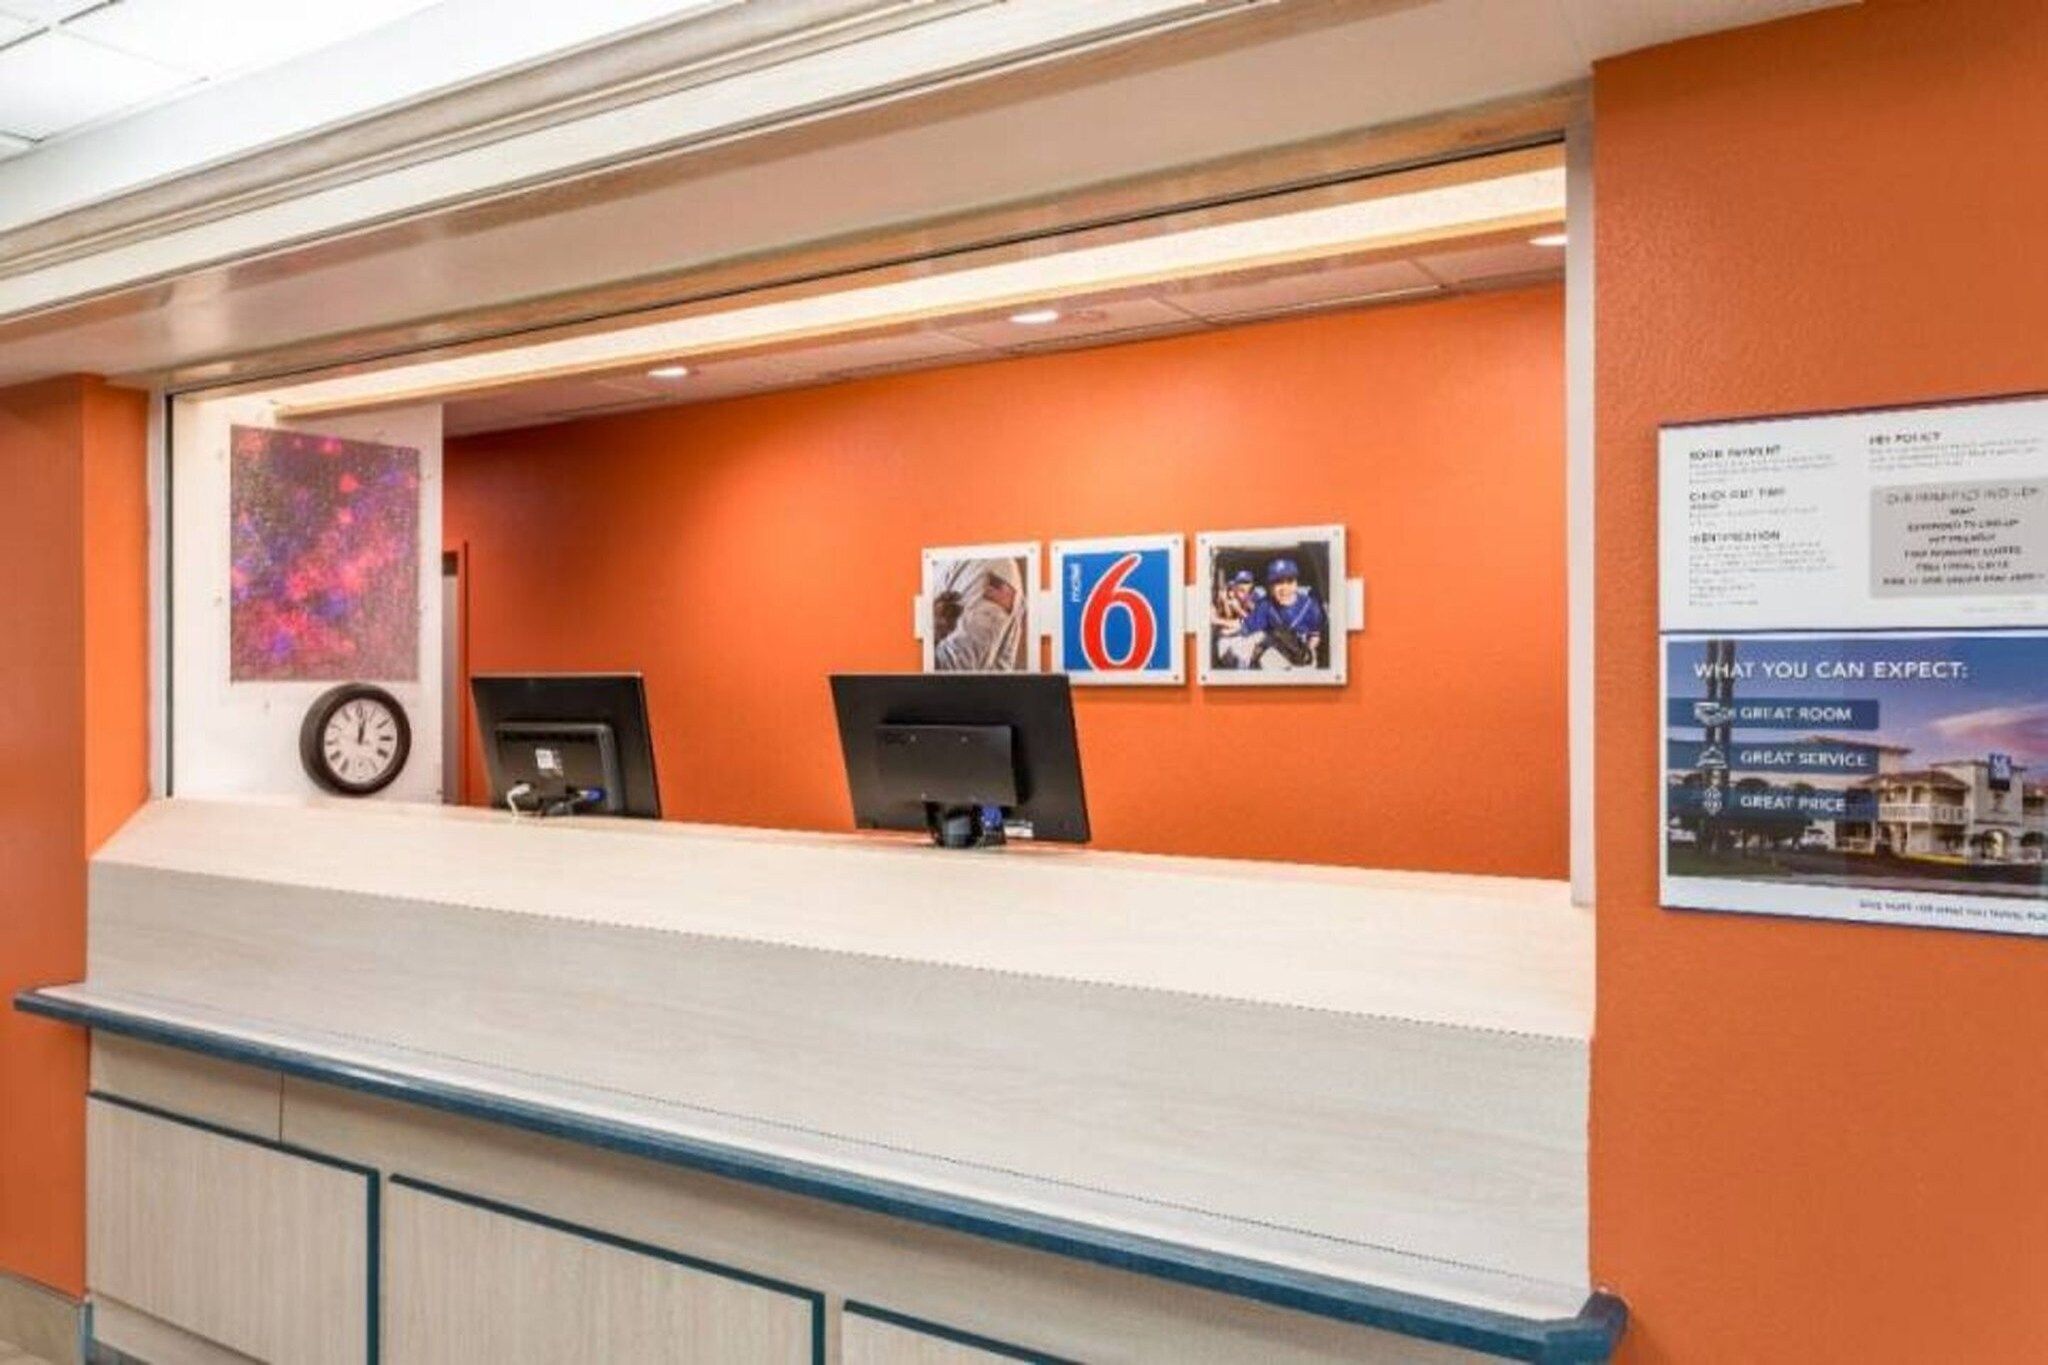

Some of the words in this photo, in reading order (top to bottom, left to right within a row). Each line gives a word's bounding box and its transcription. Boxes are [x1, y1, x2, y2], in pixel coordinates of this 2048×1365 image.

[1080, 553, 1157, 671] 6
[1694, 662, 1753, 679] WHAT
[1762, 661, 1808, 679] YOU
[1816, 661, 1864, 679] CAN
[1873, 661, 1969, 679] EXPECT:
[1740, 707, 1792, 721] GREAT
[1798, 707, 1852, 722] ROOM
[1740, 750, 1793, 765] GREAT
[1798, 752, 1868, 767] SERVICE
[1740, 795, 1793, 810] GREAT
[1798, 797, 1846, 812] PRICE
